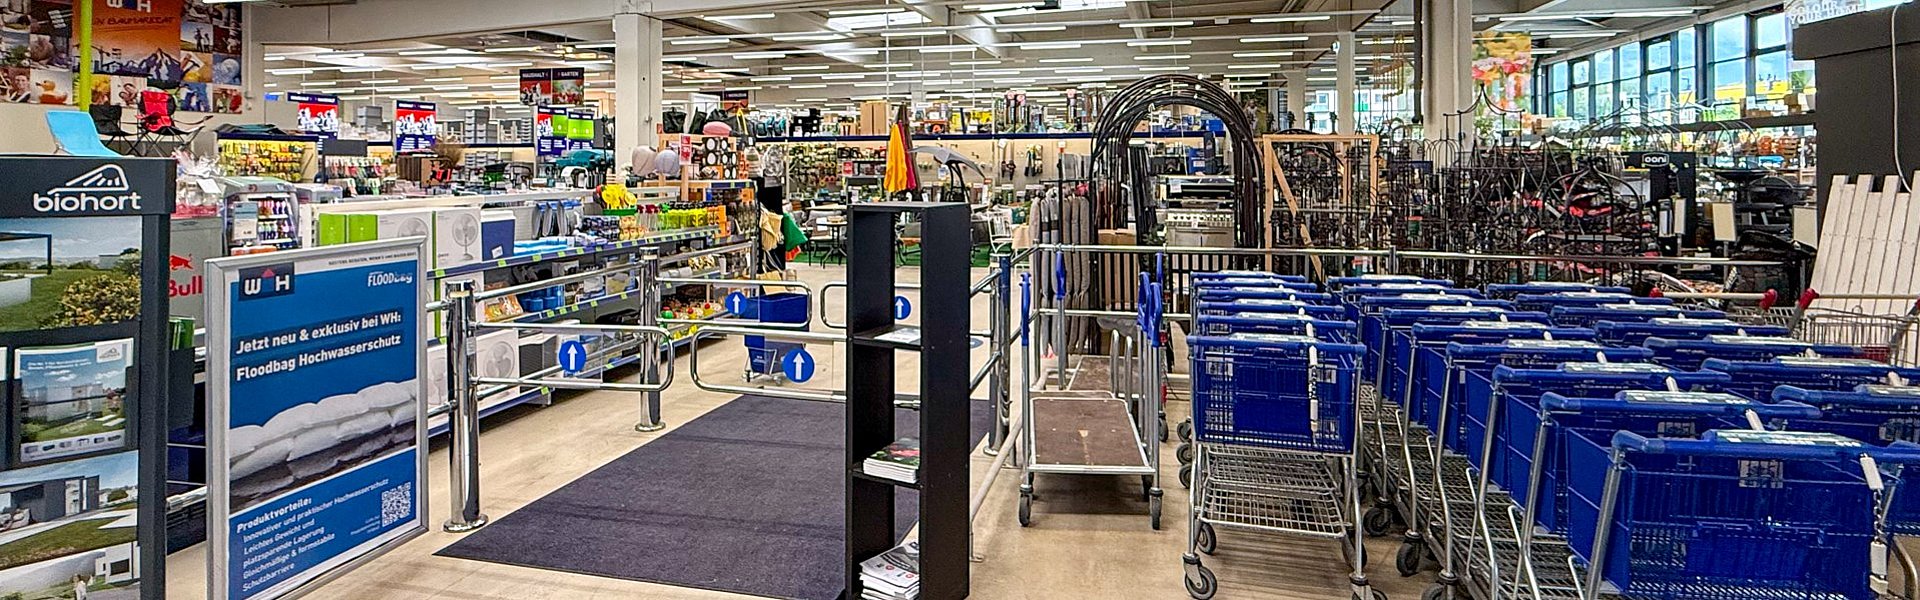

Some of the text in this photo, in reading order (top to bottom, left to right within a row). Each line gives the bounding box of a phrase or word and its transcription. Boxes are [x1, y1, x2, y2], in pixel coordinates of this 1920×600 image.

[33, 192, 141, 212] biohort
[236, 311, 402, 354] Jetzt neu & exklusiv bei WH:
[236, 334, 402, 381] Floodbag Hochwasserschutz
[236, 497, 312, 533] Produktvorteile:
[243, 478, 389, 543] Innovativer und praktischer Hochwasserschutz
[243, 517, 315, 555] Leichtes Gewicht und
[243, 526, 325, 569] platzsparende Lagerung
[291, 549, 298, 558] &
[298, 533, 335, 554] formstabile
[242, 563, 295, 592] Schutzbarriere
